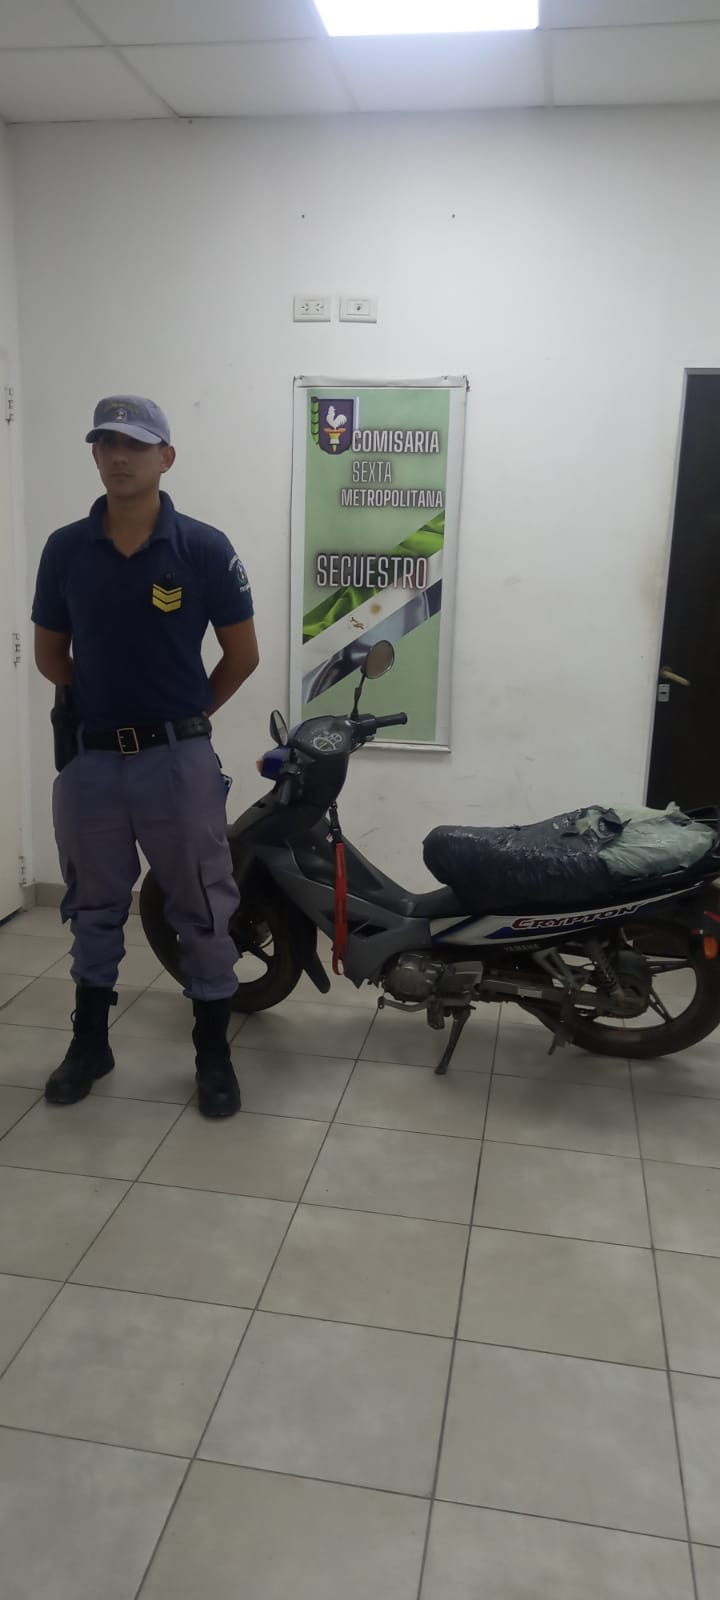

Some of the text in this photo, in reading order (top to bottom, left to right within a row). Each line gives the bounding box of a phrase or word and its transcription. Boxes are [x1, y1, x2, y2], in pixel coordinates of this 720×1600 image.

[352, 430, 440, 453] COMISARIA
[352, 461, 392, 483] SEXTA
[341, 489, 443, 508] METROPOLITANA
[316, 555, 427, 589] SECUESTRO
[511, 905, 639, 930] CRYPTON
